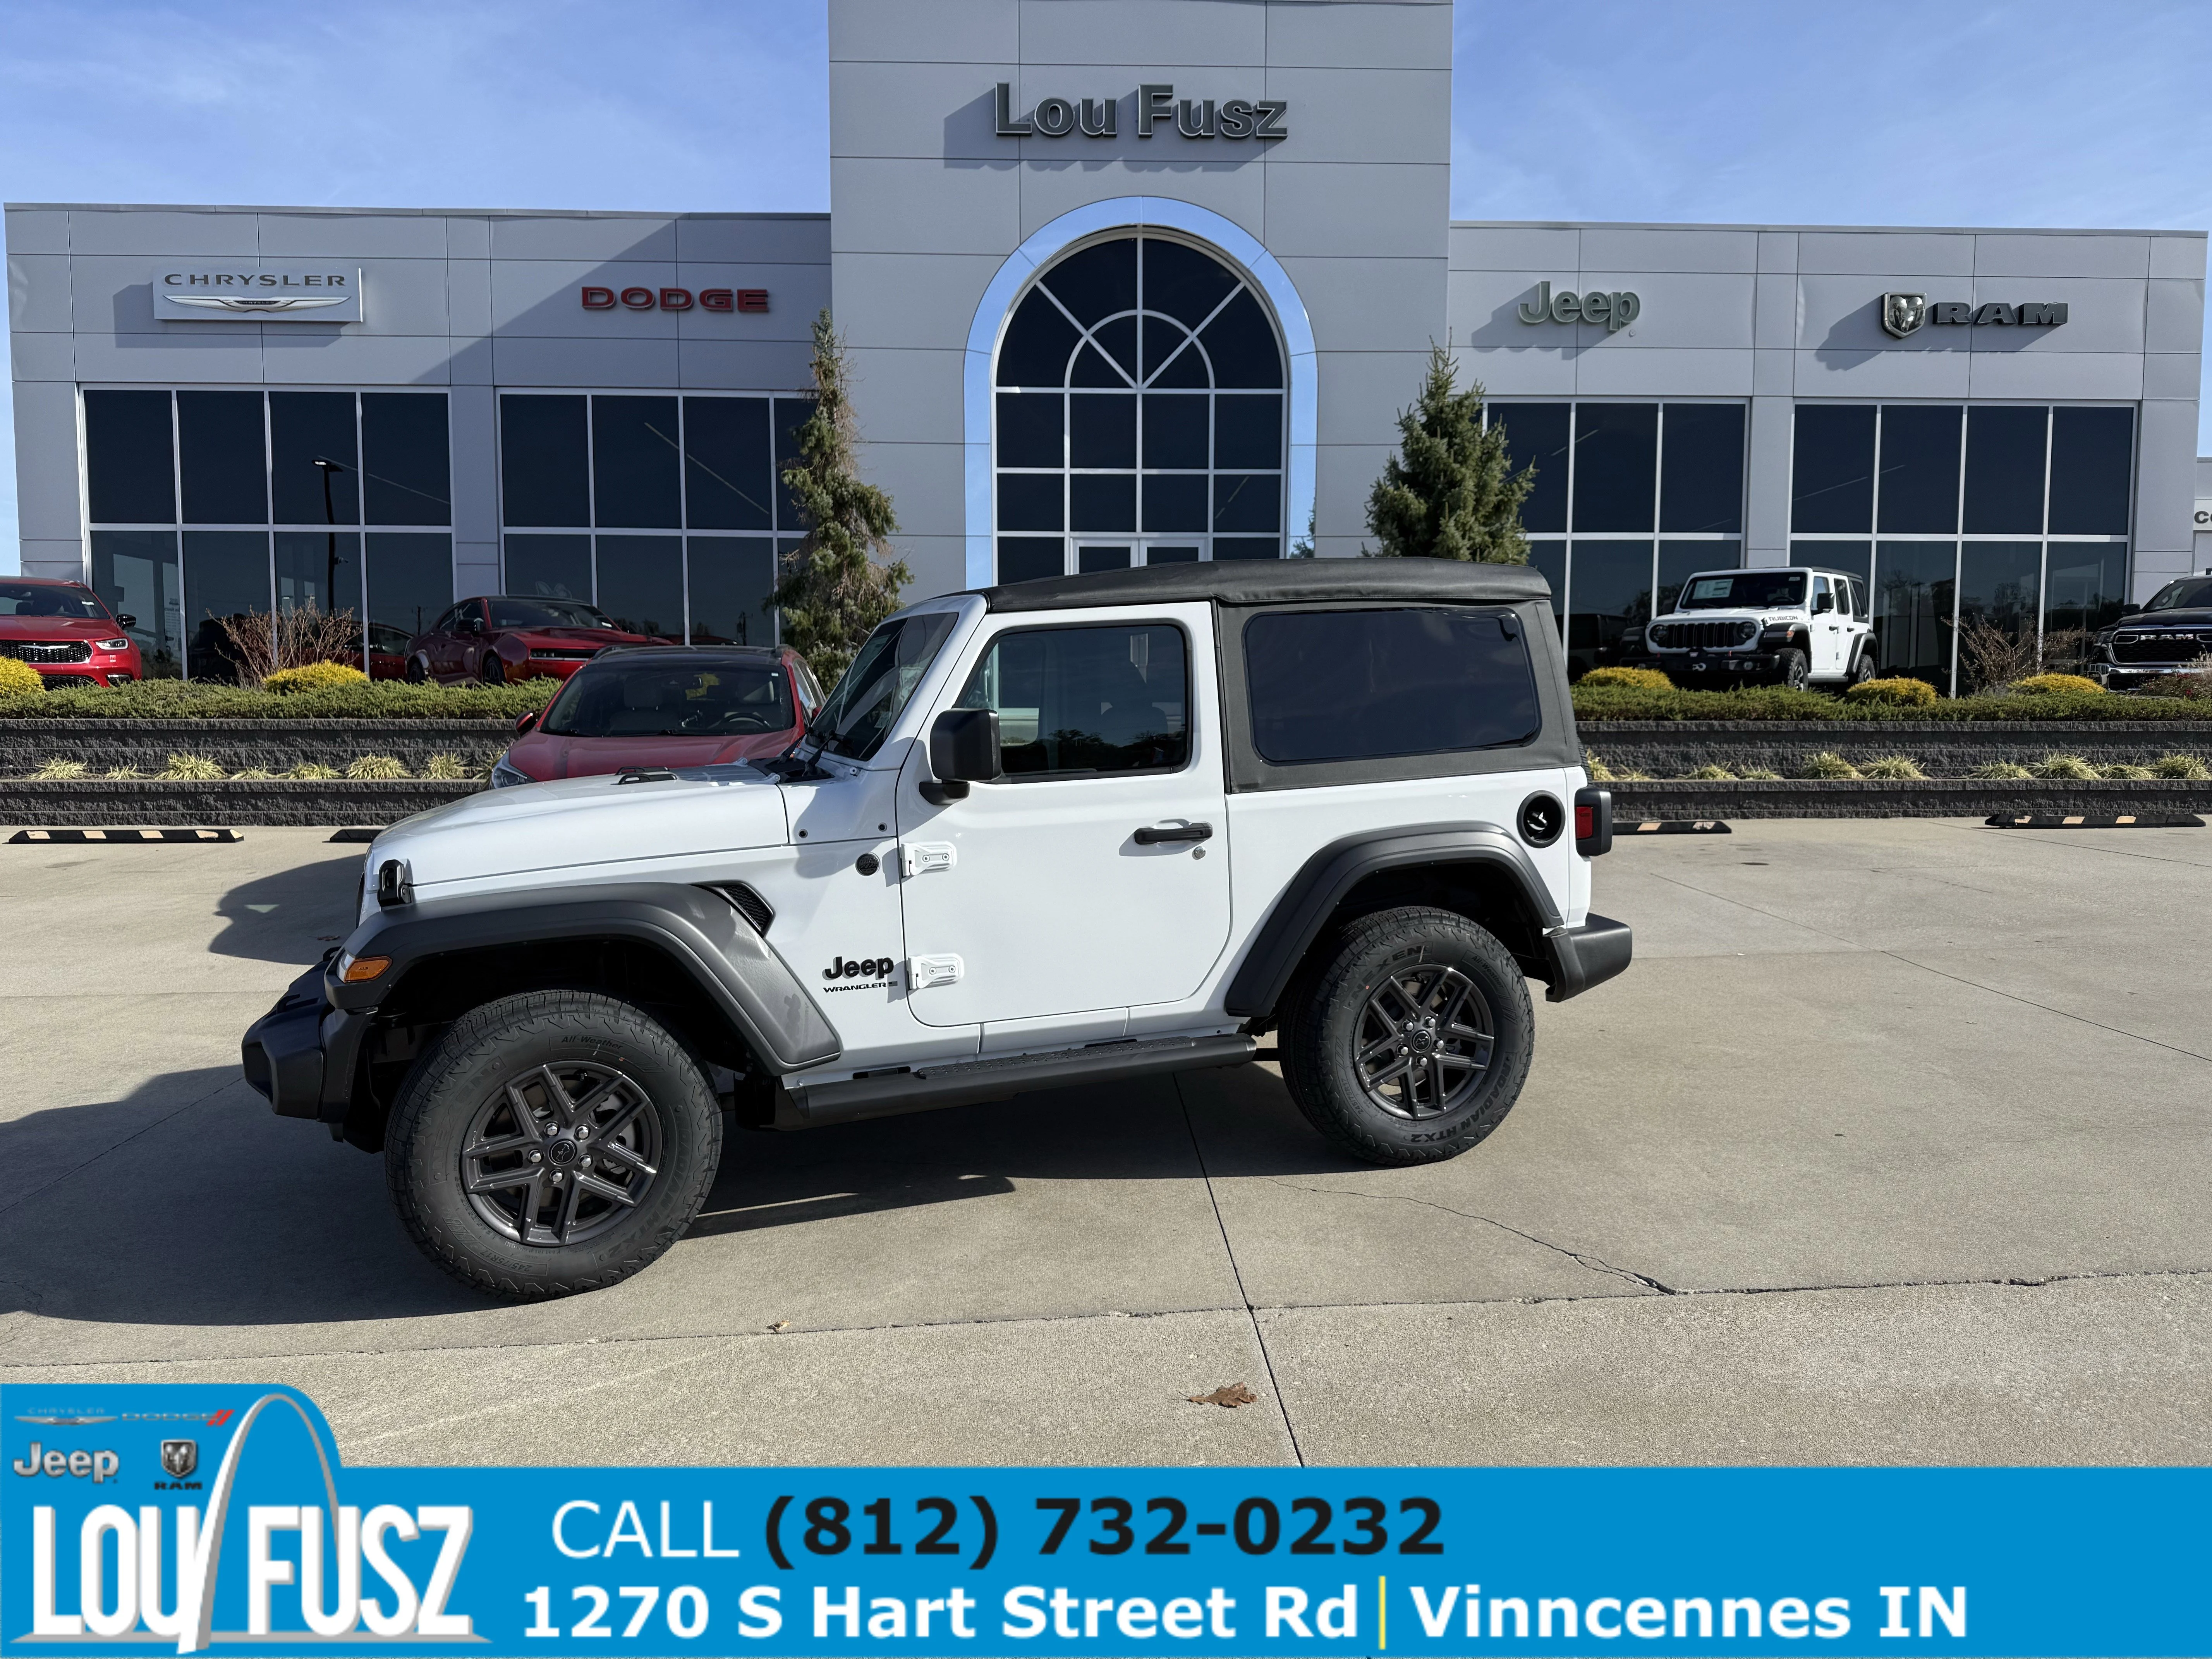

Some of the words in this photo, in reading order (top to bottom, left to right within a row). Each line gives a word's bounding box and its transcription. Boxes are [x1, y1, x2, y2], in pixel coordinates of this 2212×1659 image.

[995, 82, 1117, 138] Lou
[1138, 84, 1288, 140] Fusz
[164, 274, 346, 286] CHRYSLER
[582, 287, 769, 312] DODGE
[1518, 281, 1640, 331] Jeep
[1933, 302, 2068, 325] RAM
[823, 956, 894, 979] Jeep
[1351, 945, 1422, 1000] NEXEN
[823, 982, 887, 993] WRANGLER
[1410, 1125, 1457, 1143] HTX2
[480, 1250, 532, 1272] 245/75R17
